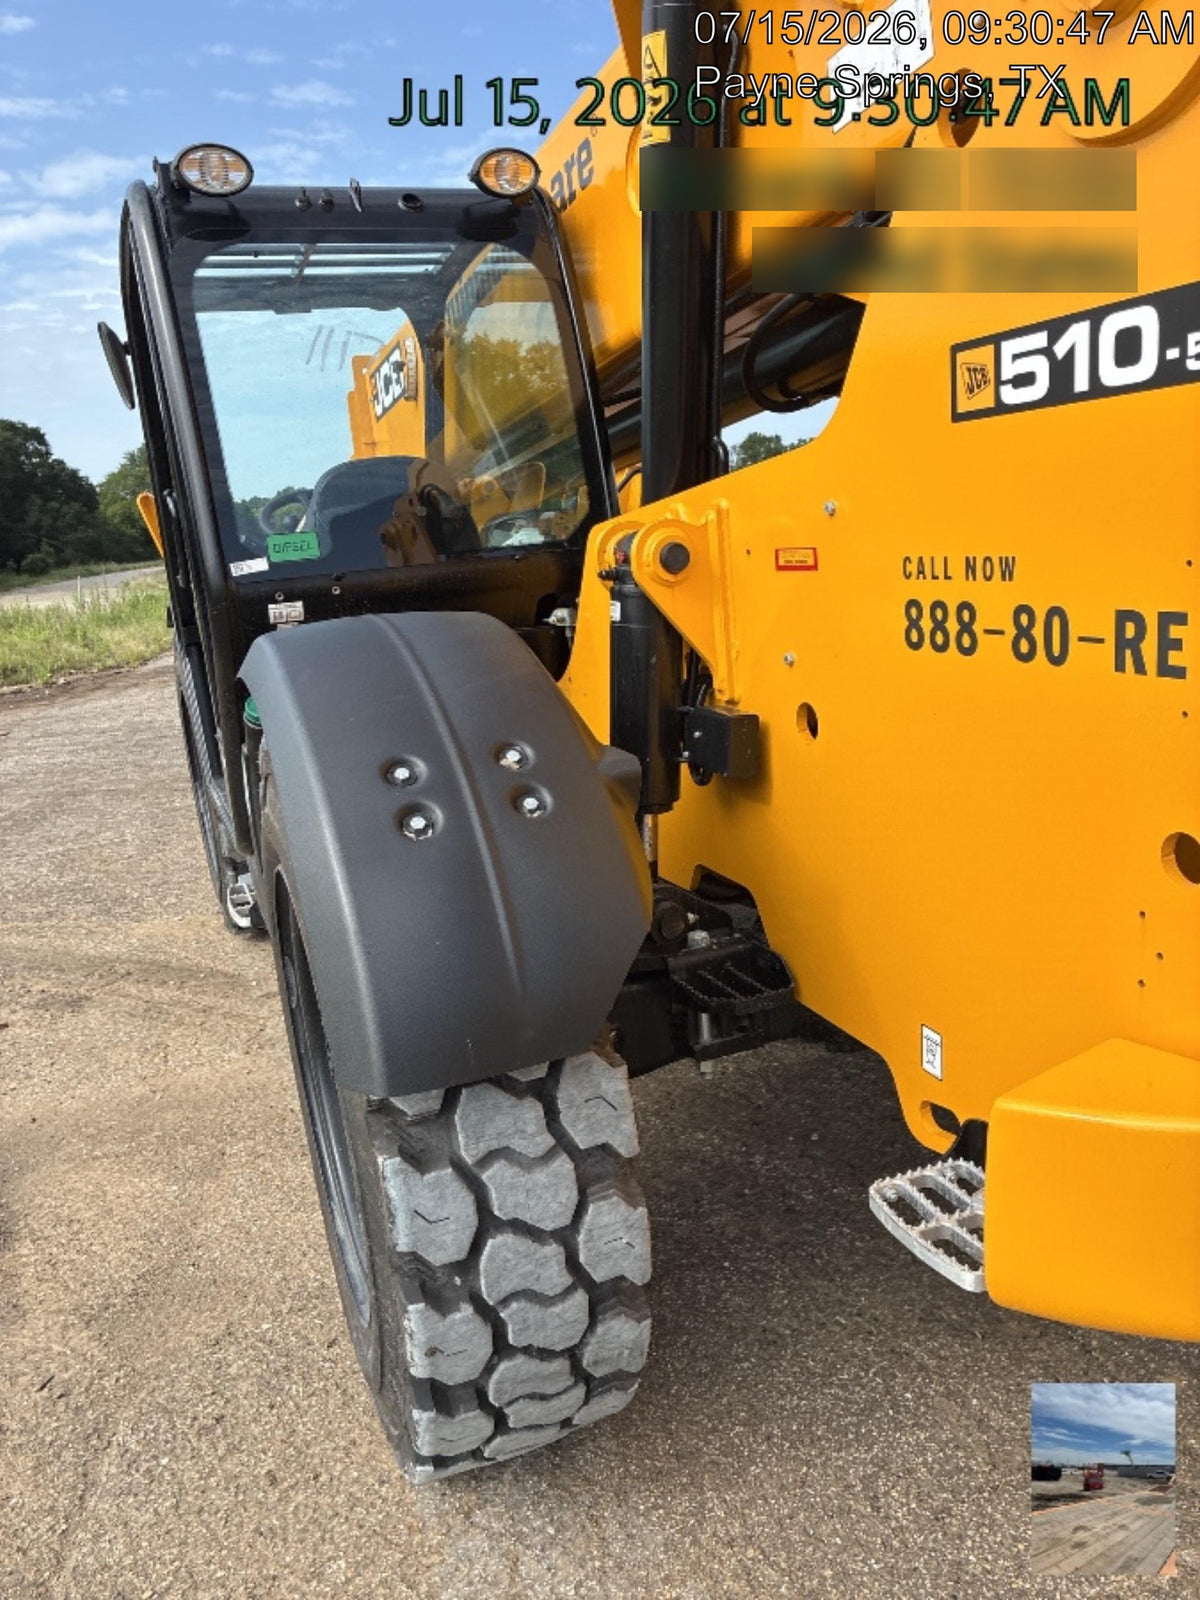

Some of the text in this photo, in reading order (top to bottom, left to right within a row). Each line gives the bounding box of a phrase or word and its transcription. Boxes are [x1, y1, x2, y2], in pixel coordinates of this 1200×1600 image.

[902, 555, 1016, 582] CALL NOW
[904, 598, 1188, 680] 888-80-RE
